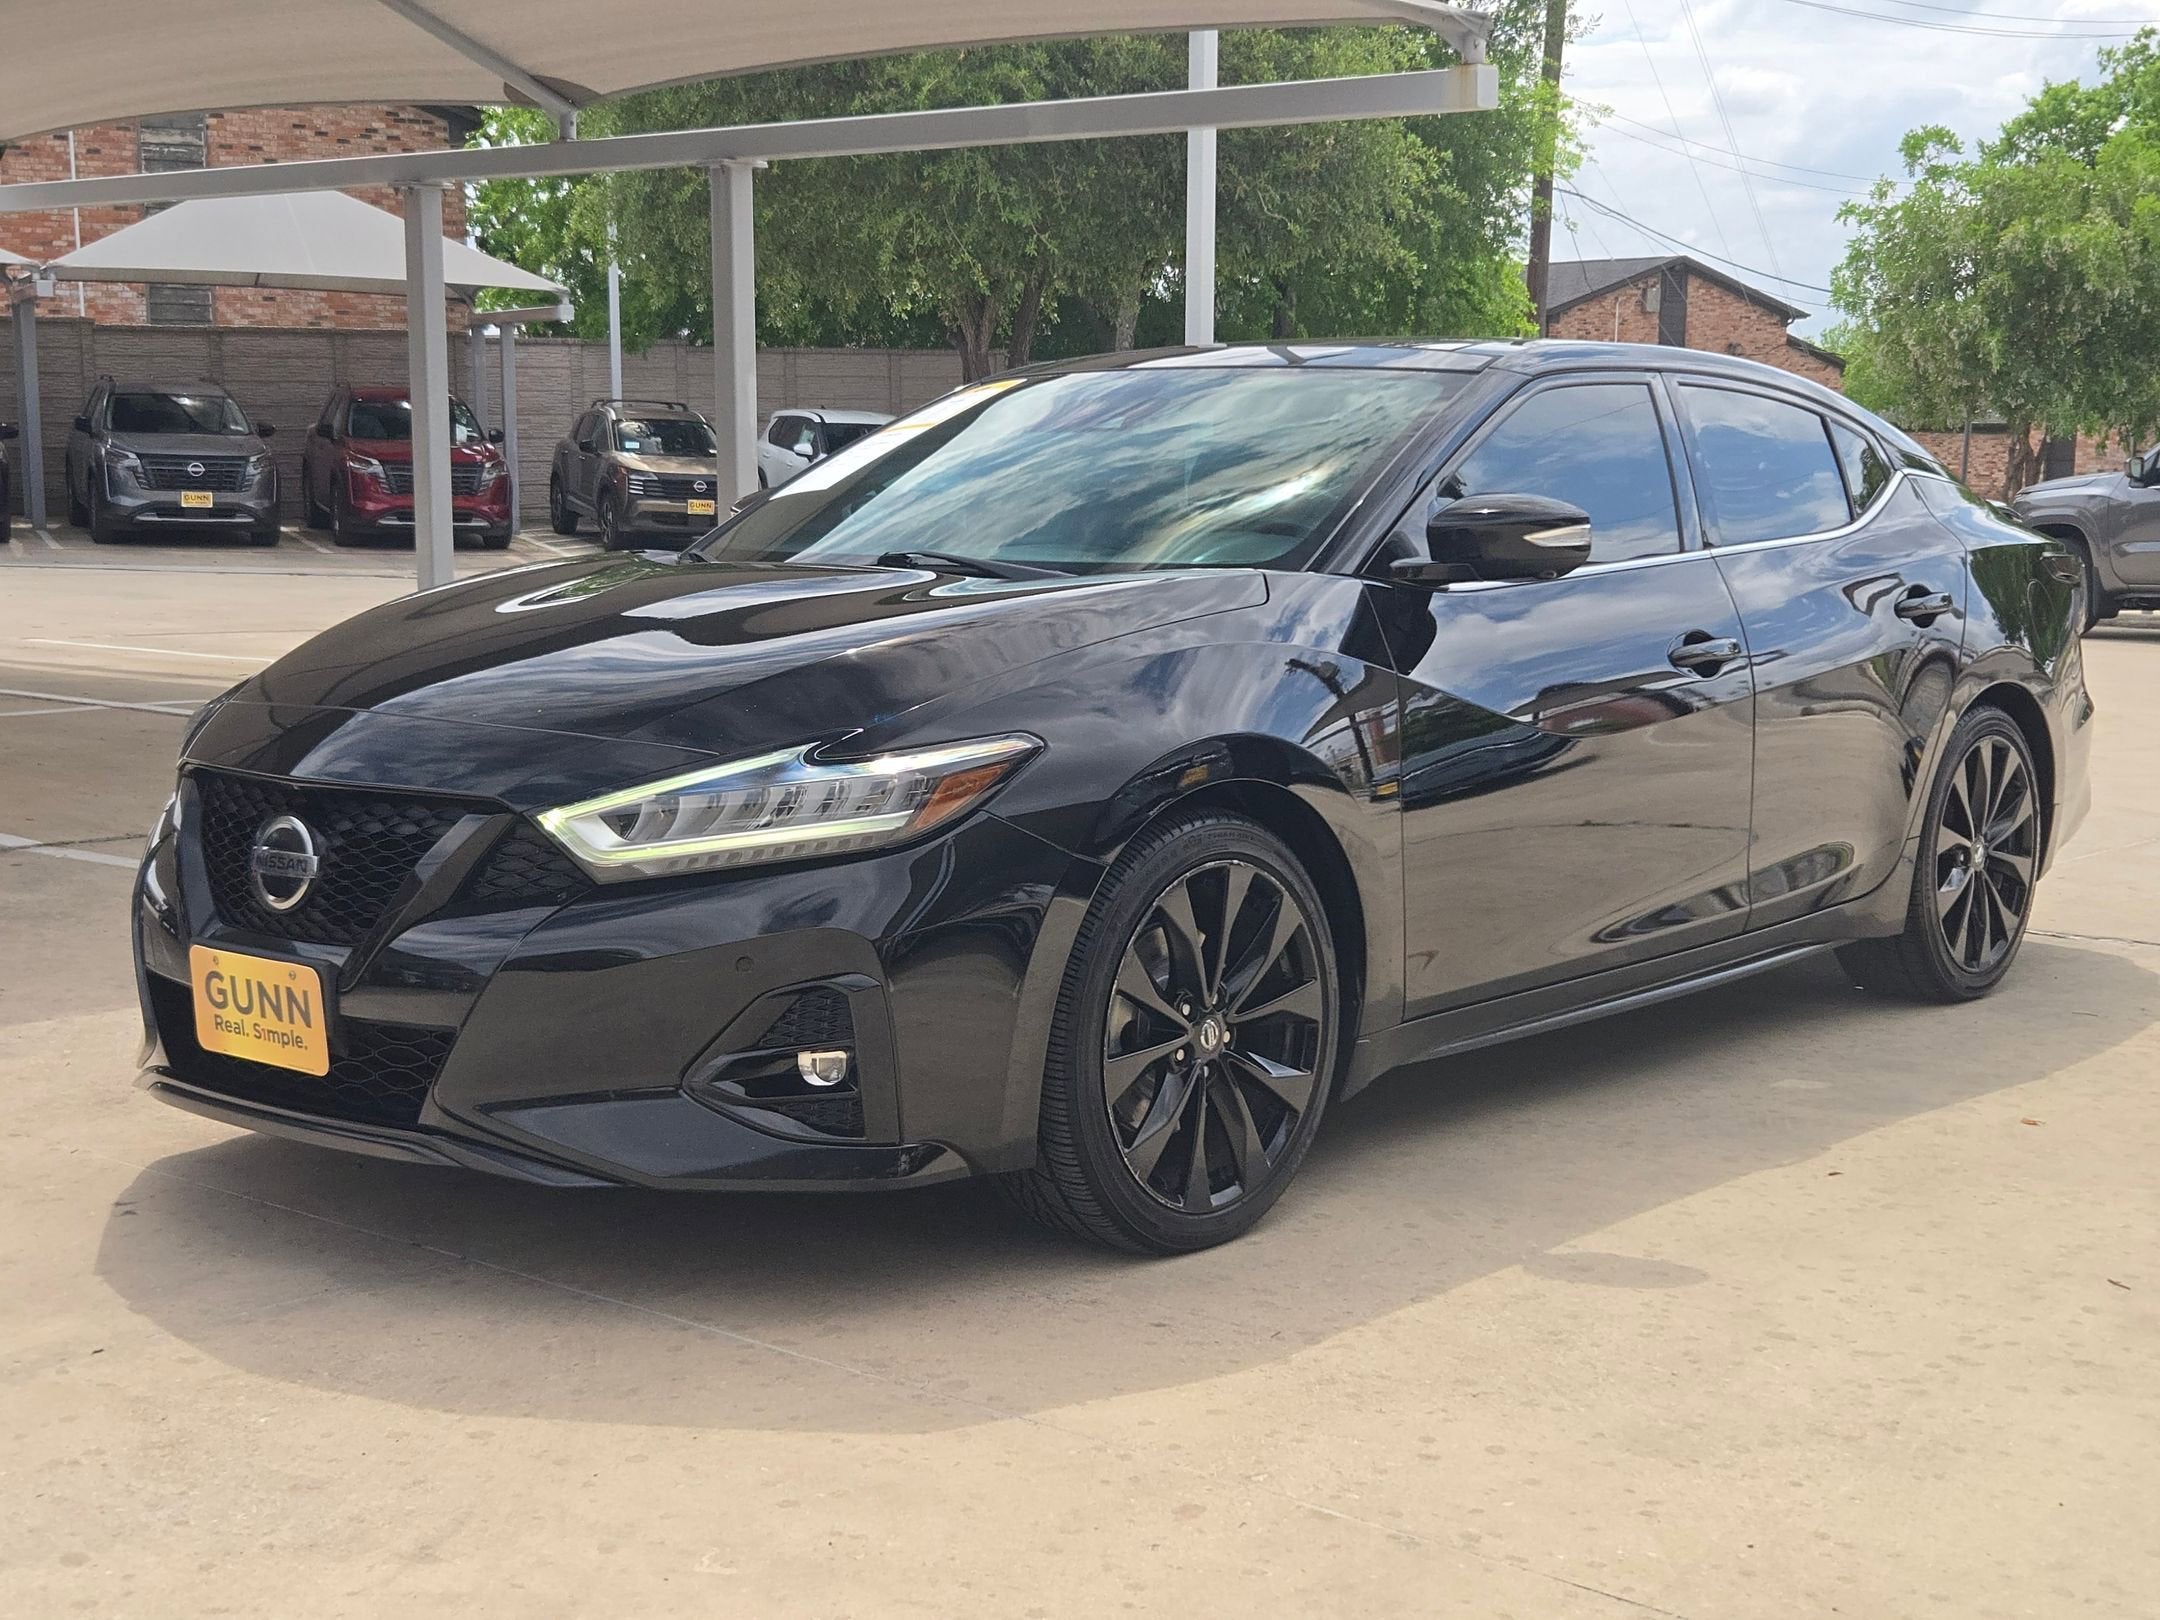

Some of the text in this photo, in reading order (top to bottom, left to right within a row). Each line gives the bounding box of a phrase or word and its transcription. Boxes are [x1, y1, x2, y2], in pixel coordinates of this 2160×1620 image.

[256, 853, 308, 873] NISSAN
[205, 970, 312, 1029] GUNN
[214, 1014, 249, 1037] Real.
